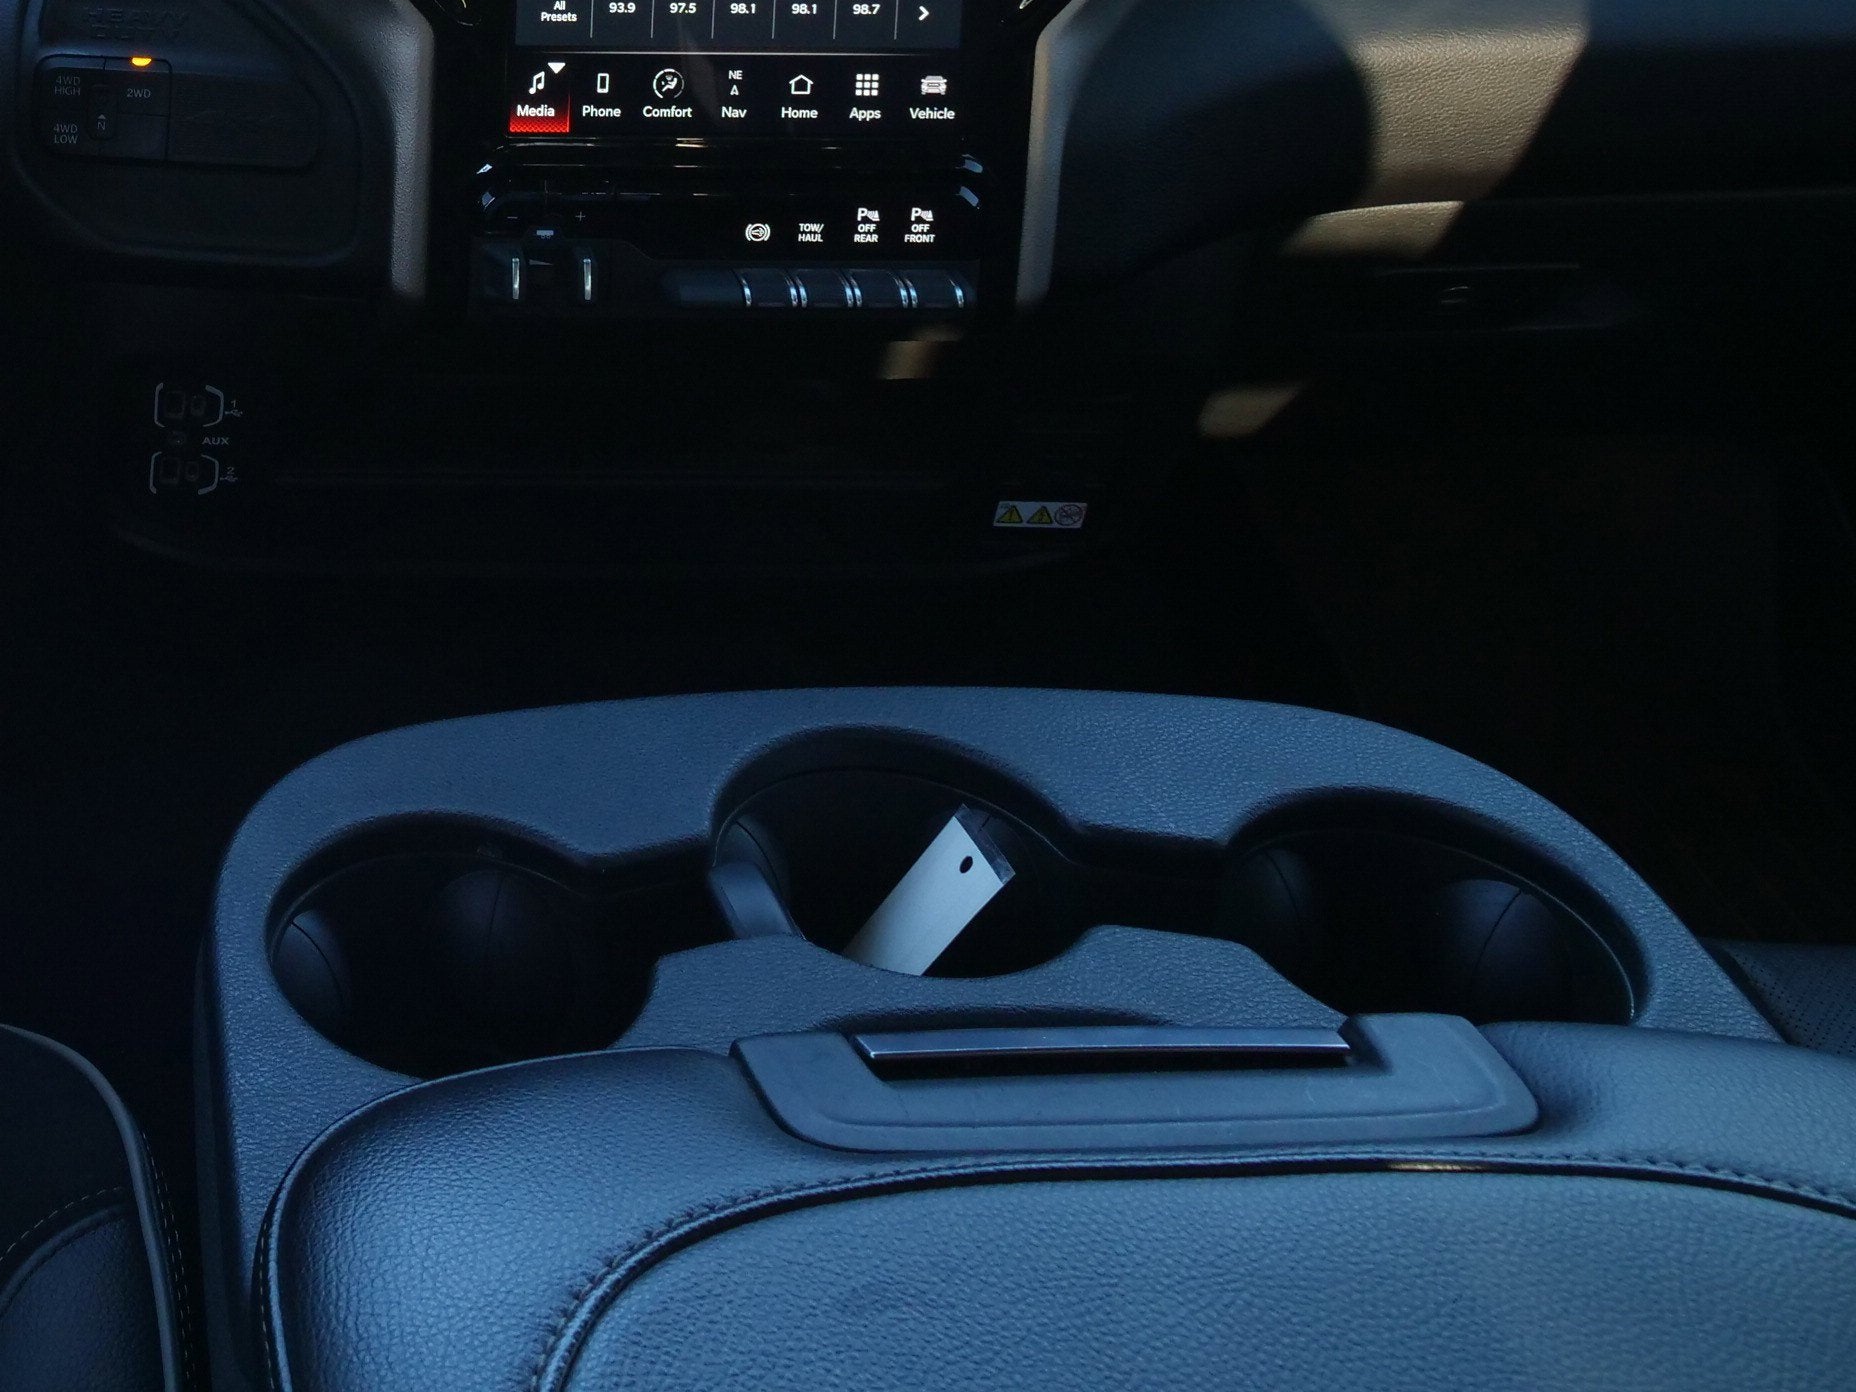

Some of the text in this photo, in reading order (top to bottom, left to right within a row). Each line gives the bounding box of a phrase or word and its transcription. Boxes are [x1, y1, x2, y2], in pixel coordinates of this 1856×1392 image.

[553, 0, 566, 11] All
[608, 2, 636, 14] 93.9
[669, 2, 697, 14] 97.5
[730, 3, 756, 14] 98.1
[791, 3, 818, 15] 98.1
[852, 3, 880, 15] 98.7
[540, 12, 577, 22] Presets
[728, 70, 743, 80] NE
[55, 76, 81, 86] 4WD
[54, 86, 81, 97] HIGH
[126, 87, 152, 99] 2WD
[516, 105, 555, 117] Media
[582, 106, 621, 118] Phone
[643, 106, 693, 118] Comfort
[721, 107, 748, 118] Nav
[781, 107, 818, 119] Home
[849, 107, 882, 122] Apps
[909, 107, 956, 120] Vehicle
[53, 124, 78, 134] 4WD
[97, 120, 106, 131] N
[54, 134, 79, 145] LOW
[798, 223, 824, 233] TOW/
[857, 224, 877, 232] OFF
[911, 224, 930, 233] OFF
[798, 233, 823, 242] HAUL
[853, 234, 878, 243] REAR
[904, 234, 936, 243] FRONT
[202, 436, 229, 445] AUX
